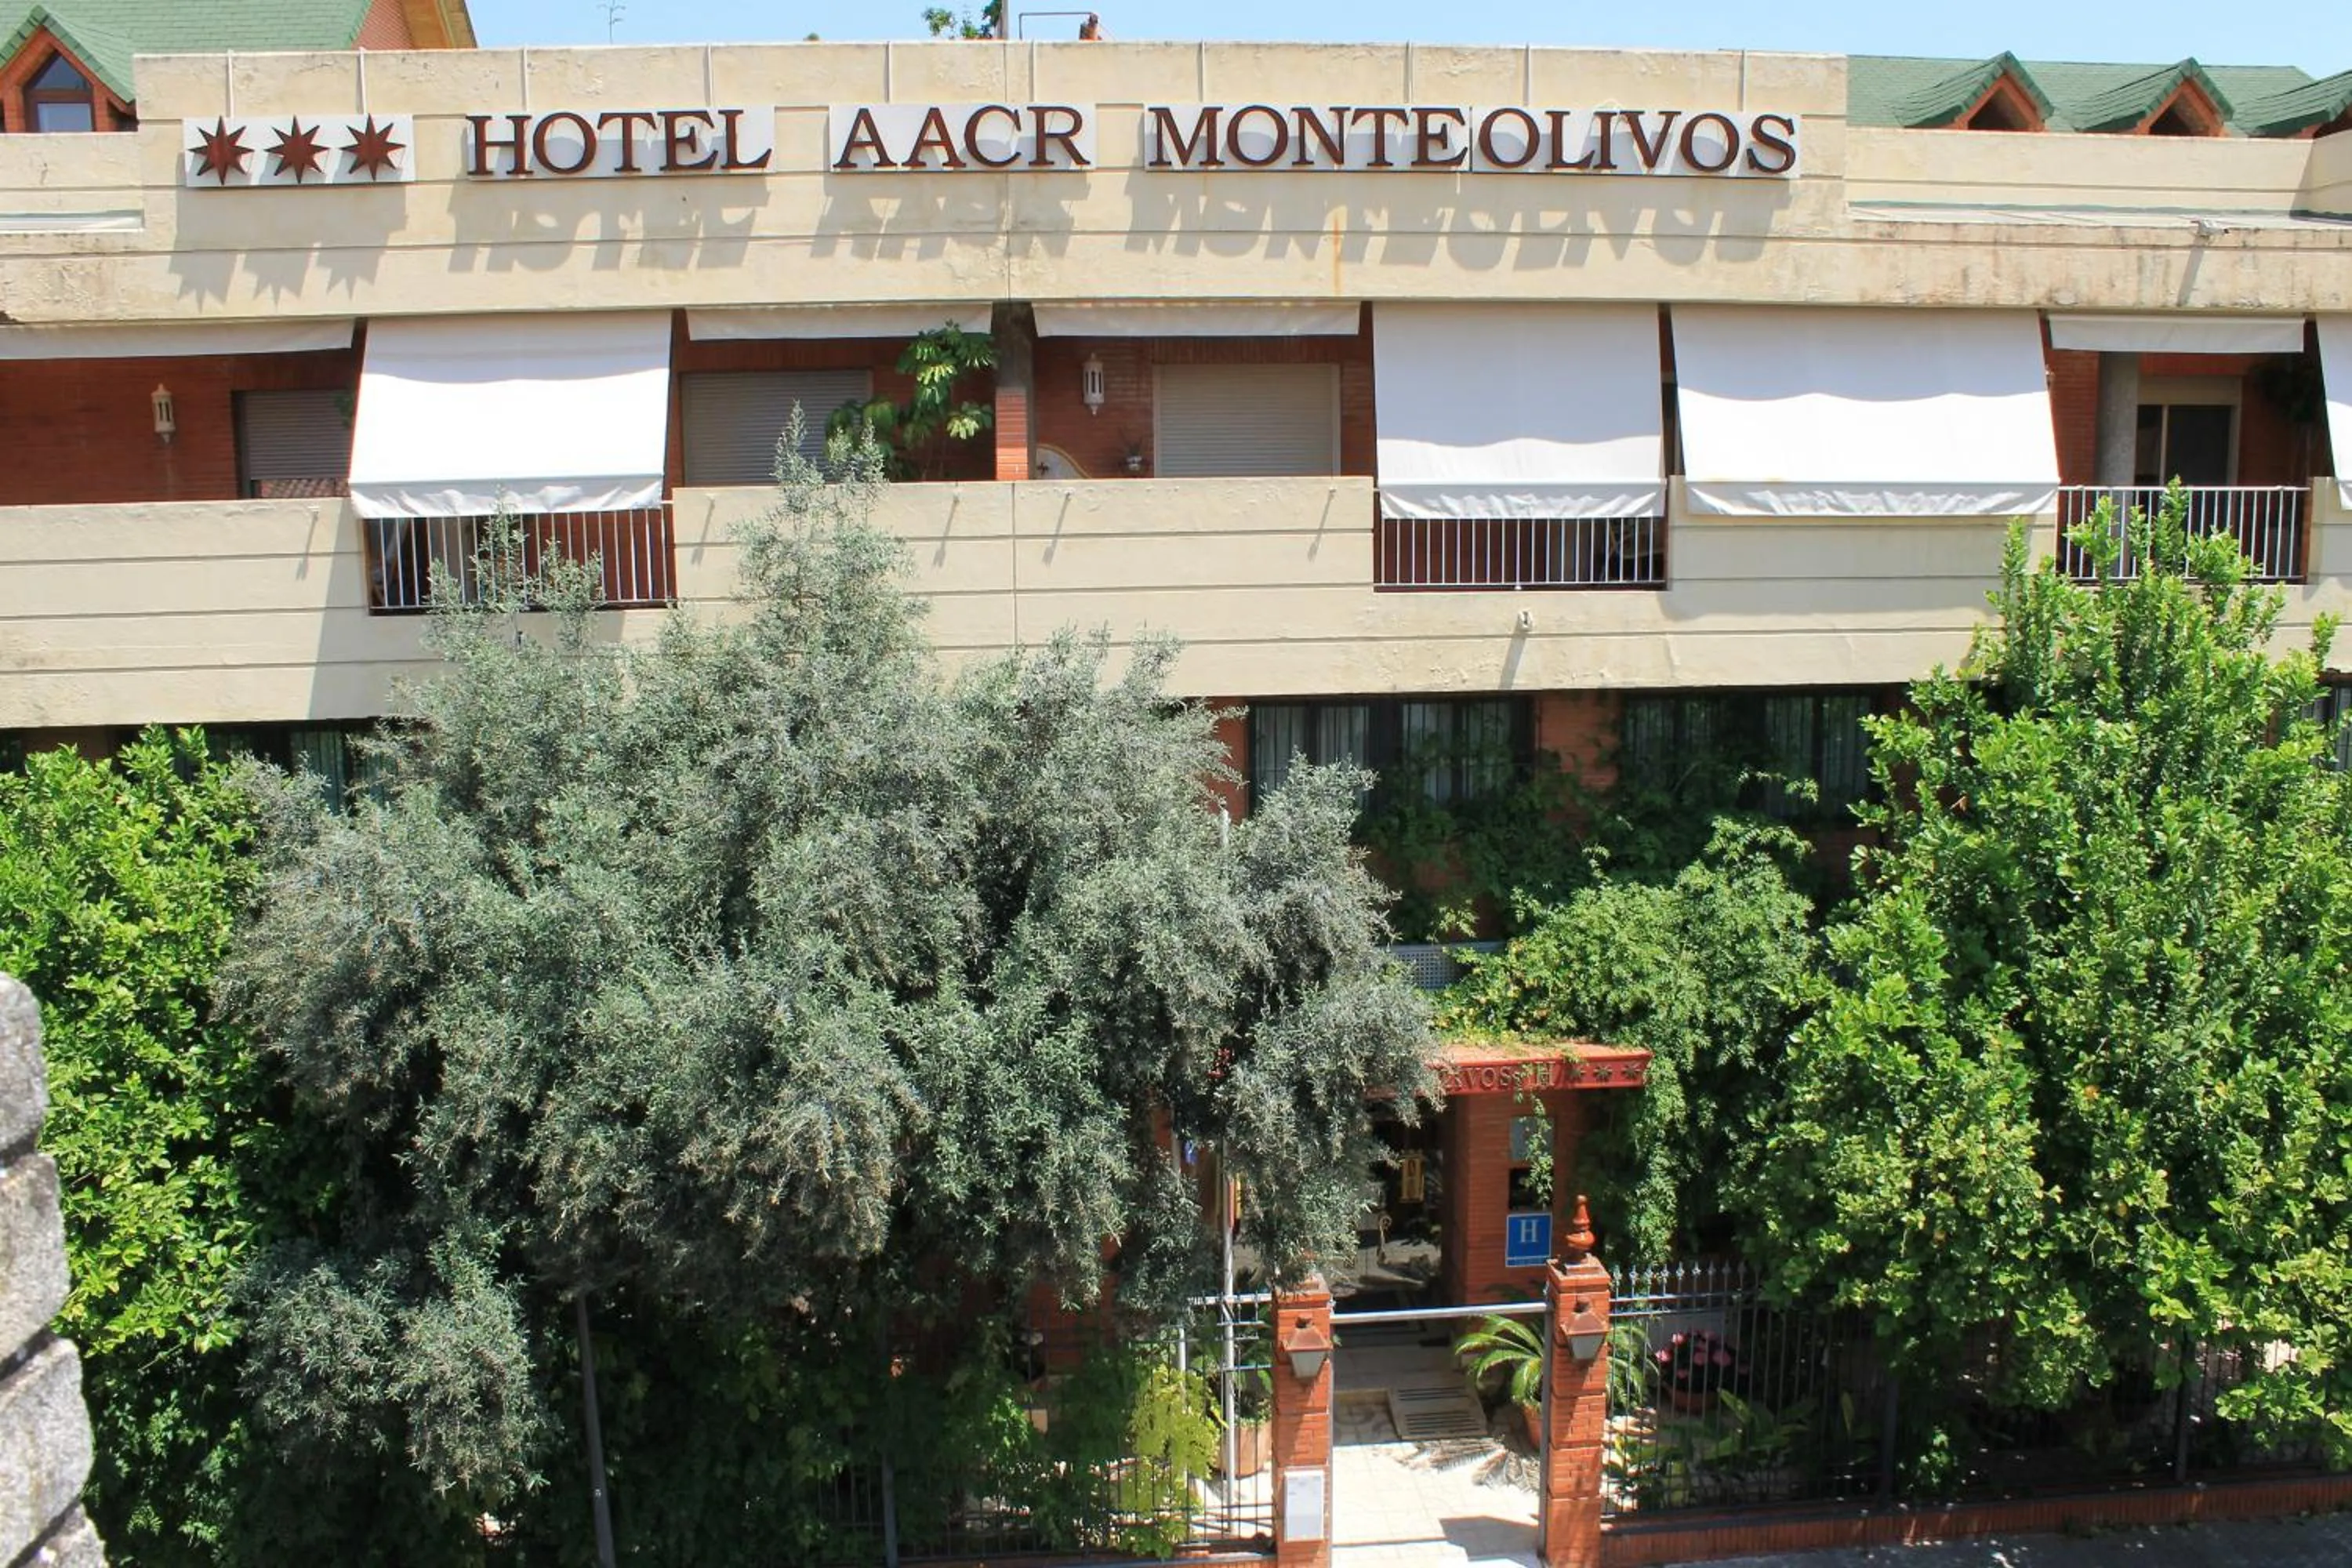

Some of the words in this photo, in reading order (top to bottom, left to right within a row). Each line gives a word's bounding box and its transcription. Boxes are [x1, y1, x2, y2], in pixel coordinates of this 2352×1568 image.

[465, 110, 771, 176] HOTEL
[833, 105, 1091, 168] AACR
[1148, 105, 1795, 174] MONTEOLIVOS
[1519, 1219, 1538, 1243] H
